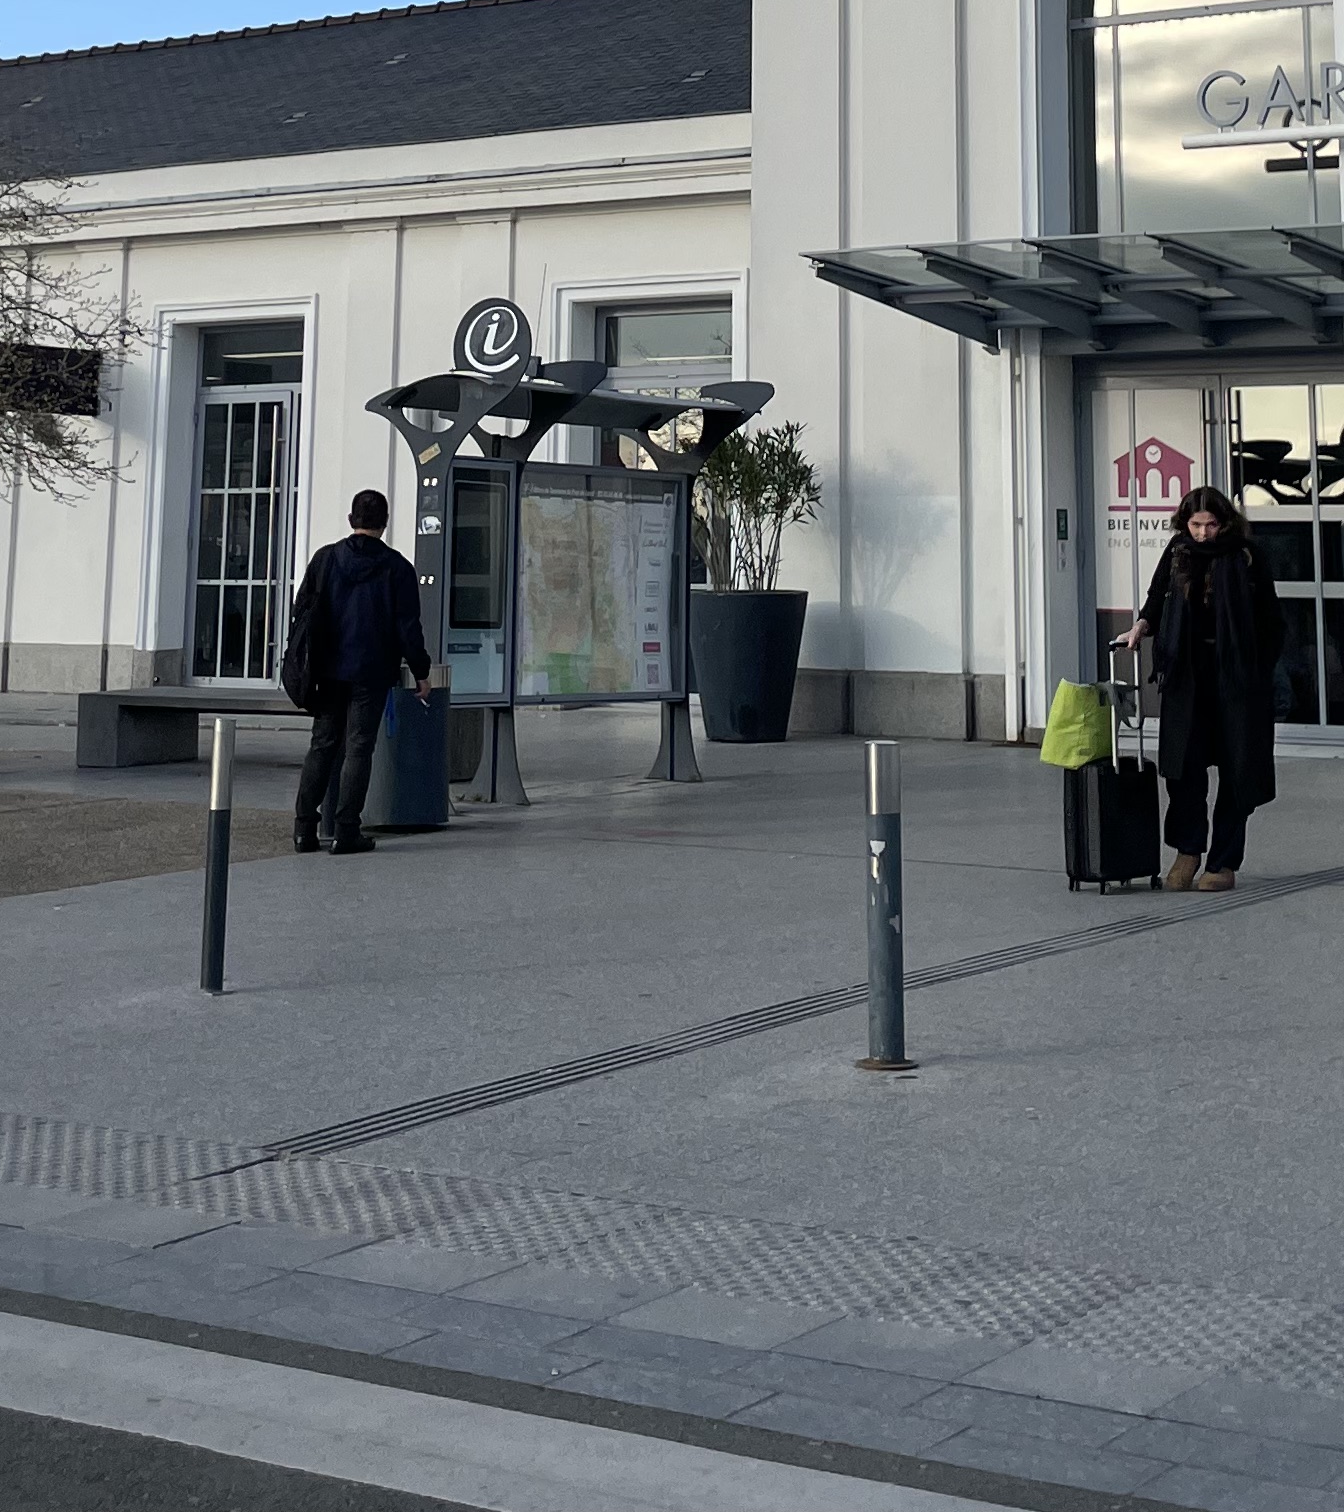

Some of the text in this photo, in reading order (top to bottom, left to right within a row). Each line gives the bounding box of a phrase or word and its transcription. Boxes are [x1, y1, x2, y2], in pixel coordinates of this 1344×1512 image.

[1108, 519, 1171, 531] BIENVE
[1123, 538, 1158, 548] GARE
[1160, 538, 1170, 548] D
